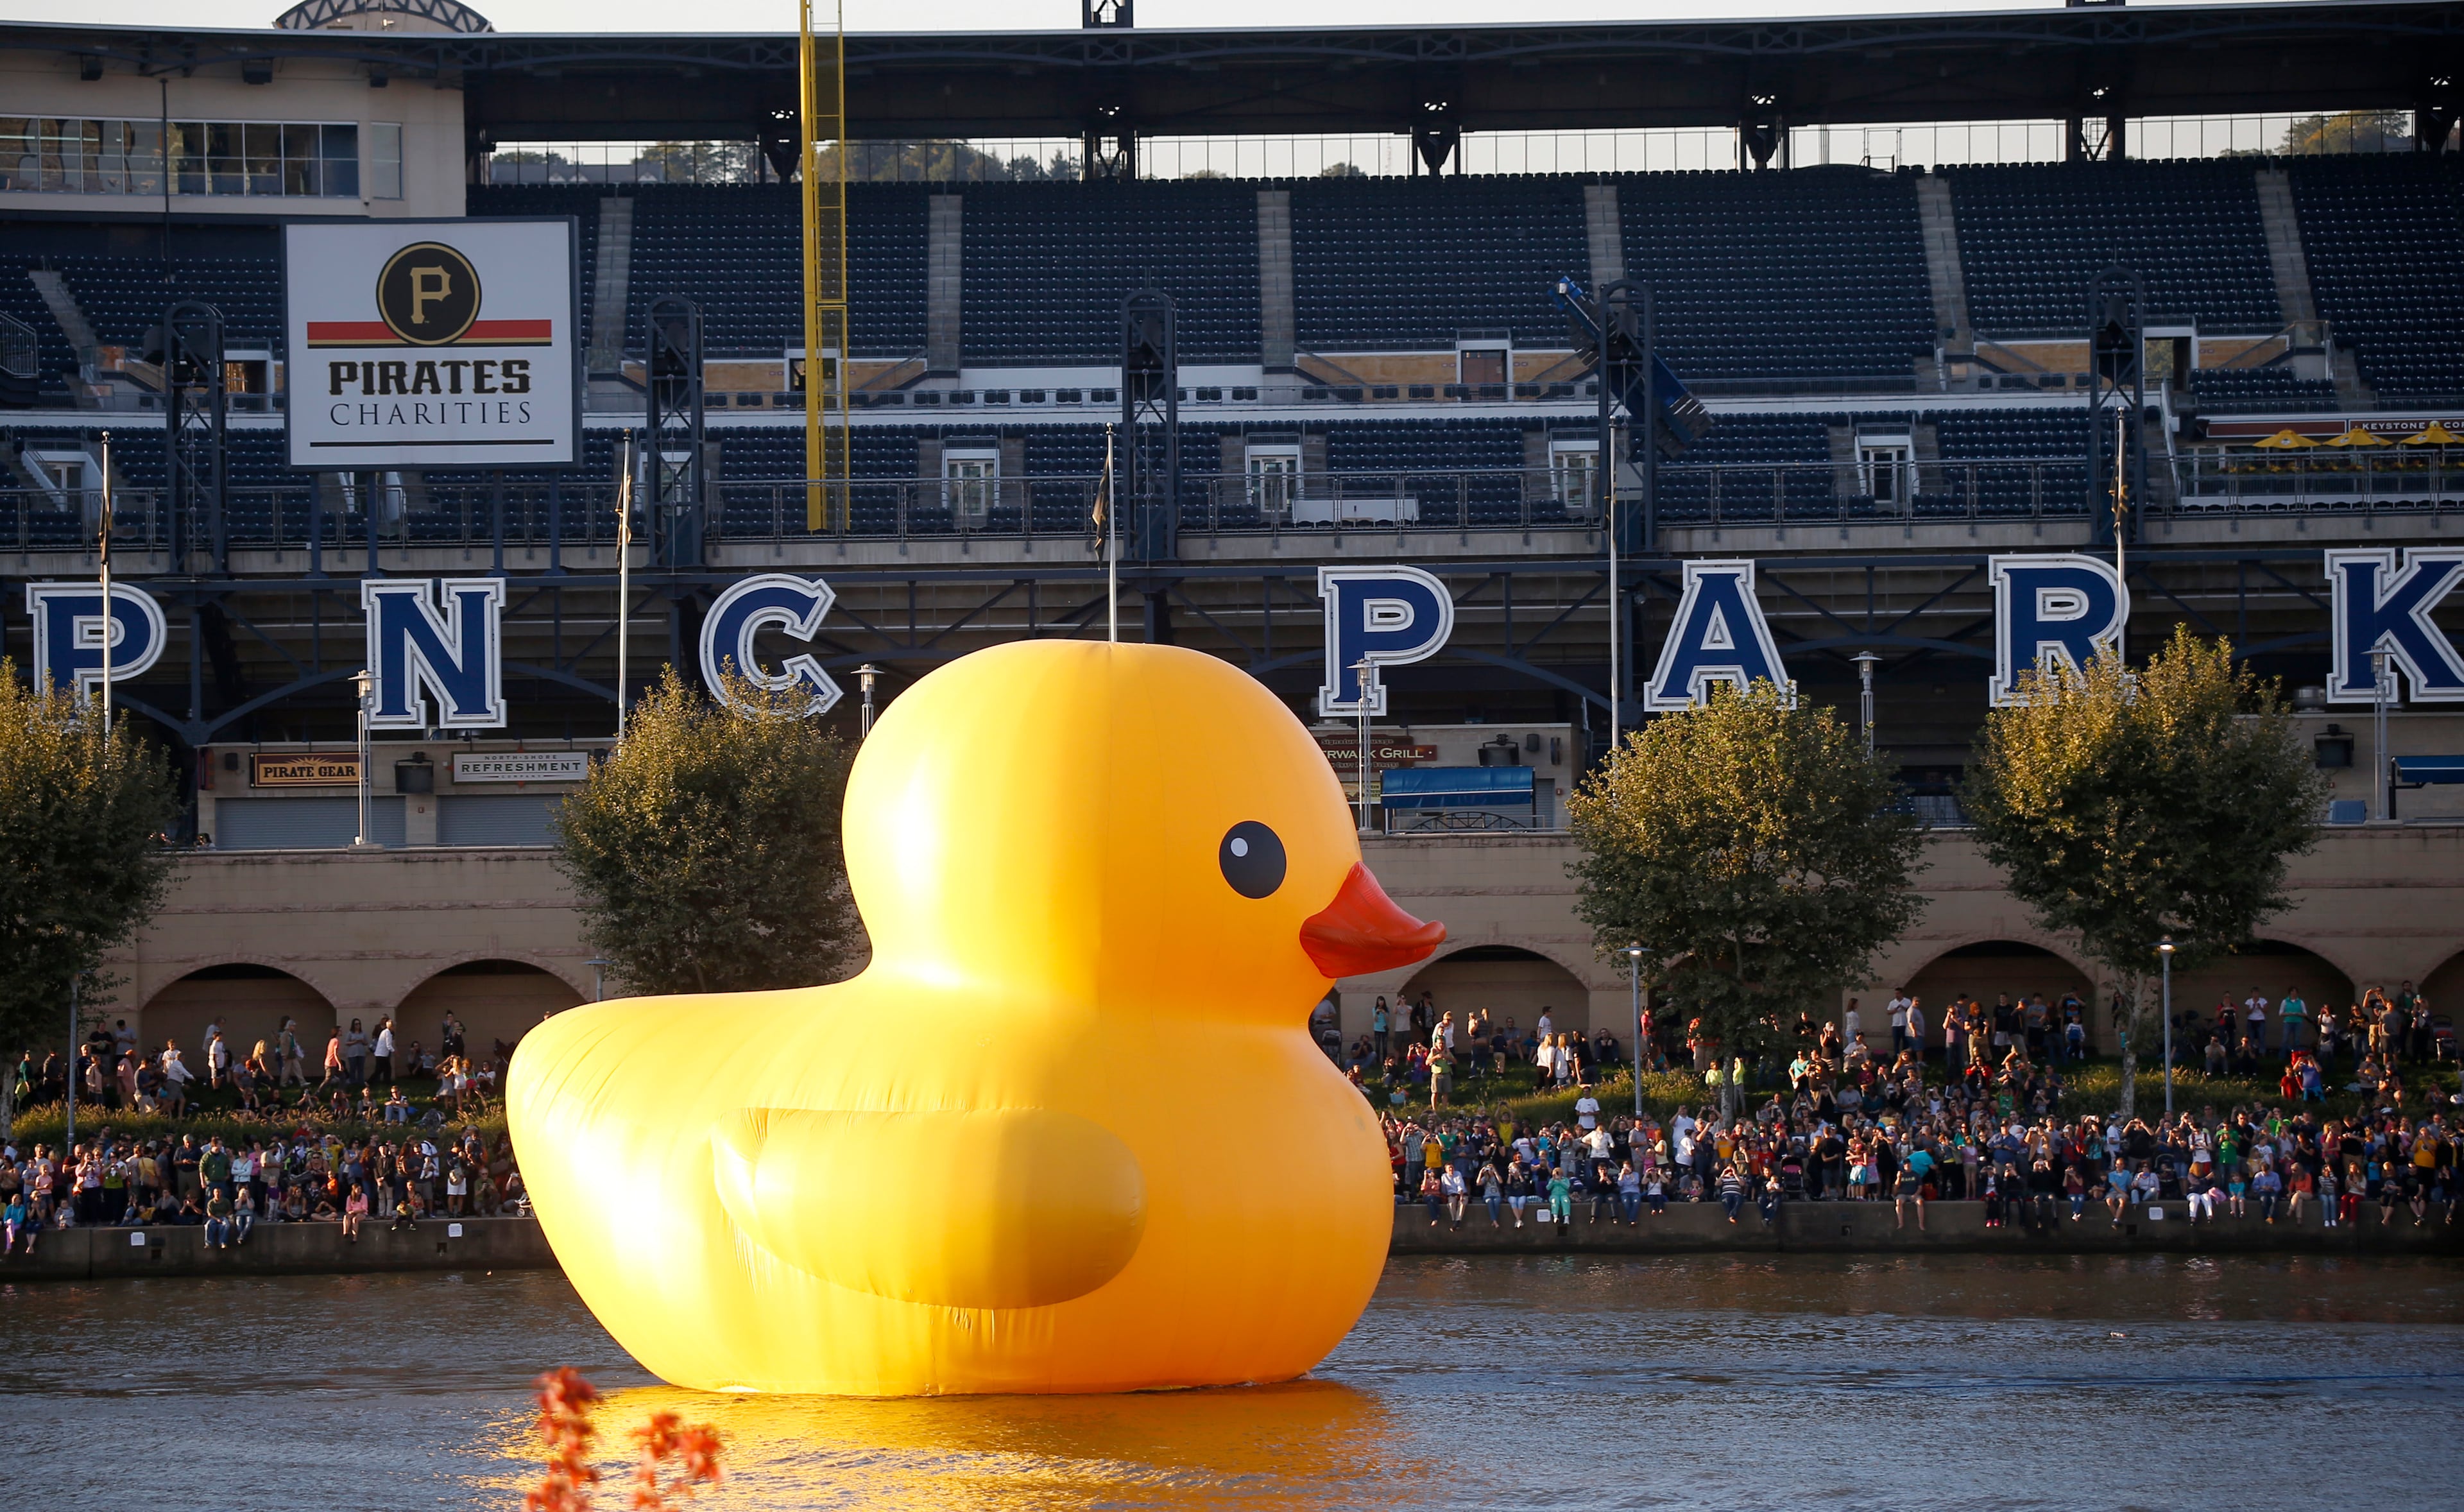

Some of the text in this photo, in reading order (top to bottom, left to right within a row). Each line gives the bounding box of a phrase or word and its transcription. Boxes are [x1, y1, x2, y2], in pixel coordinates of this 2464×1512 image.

[409, 265, 452, 324] P
[329, 359, 531, 396] PIRATES
[330, 401, 531, 425] CHARITIES
[2362, 422, 2426, 430] KEYSTONE
[264, 766, 356, 778] PIRATE GEAR
[461, 762, 581, 772] REFRESHMENT
